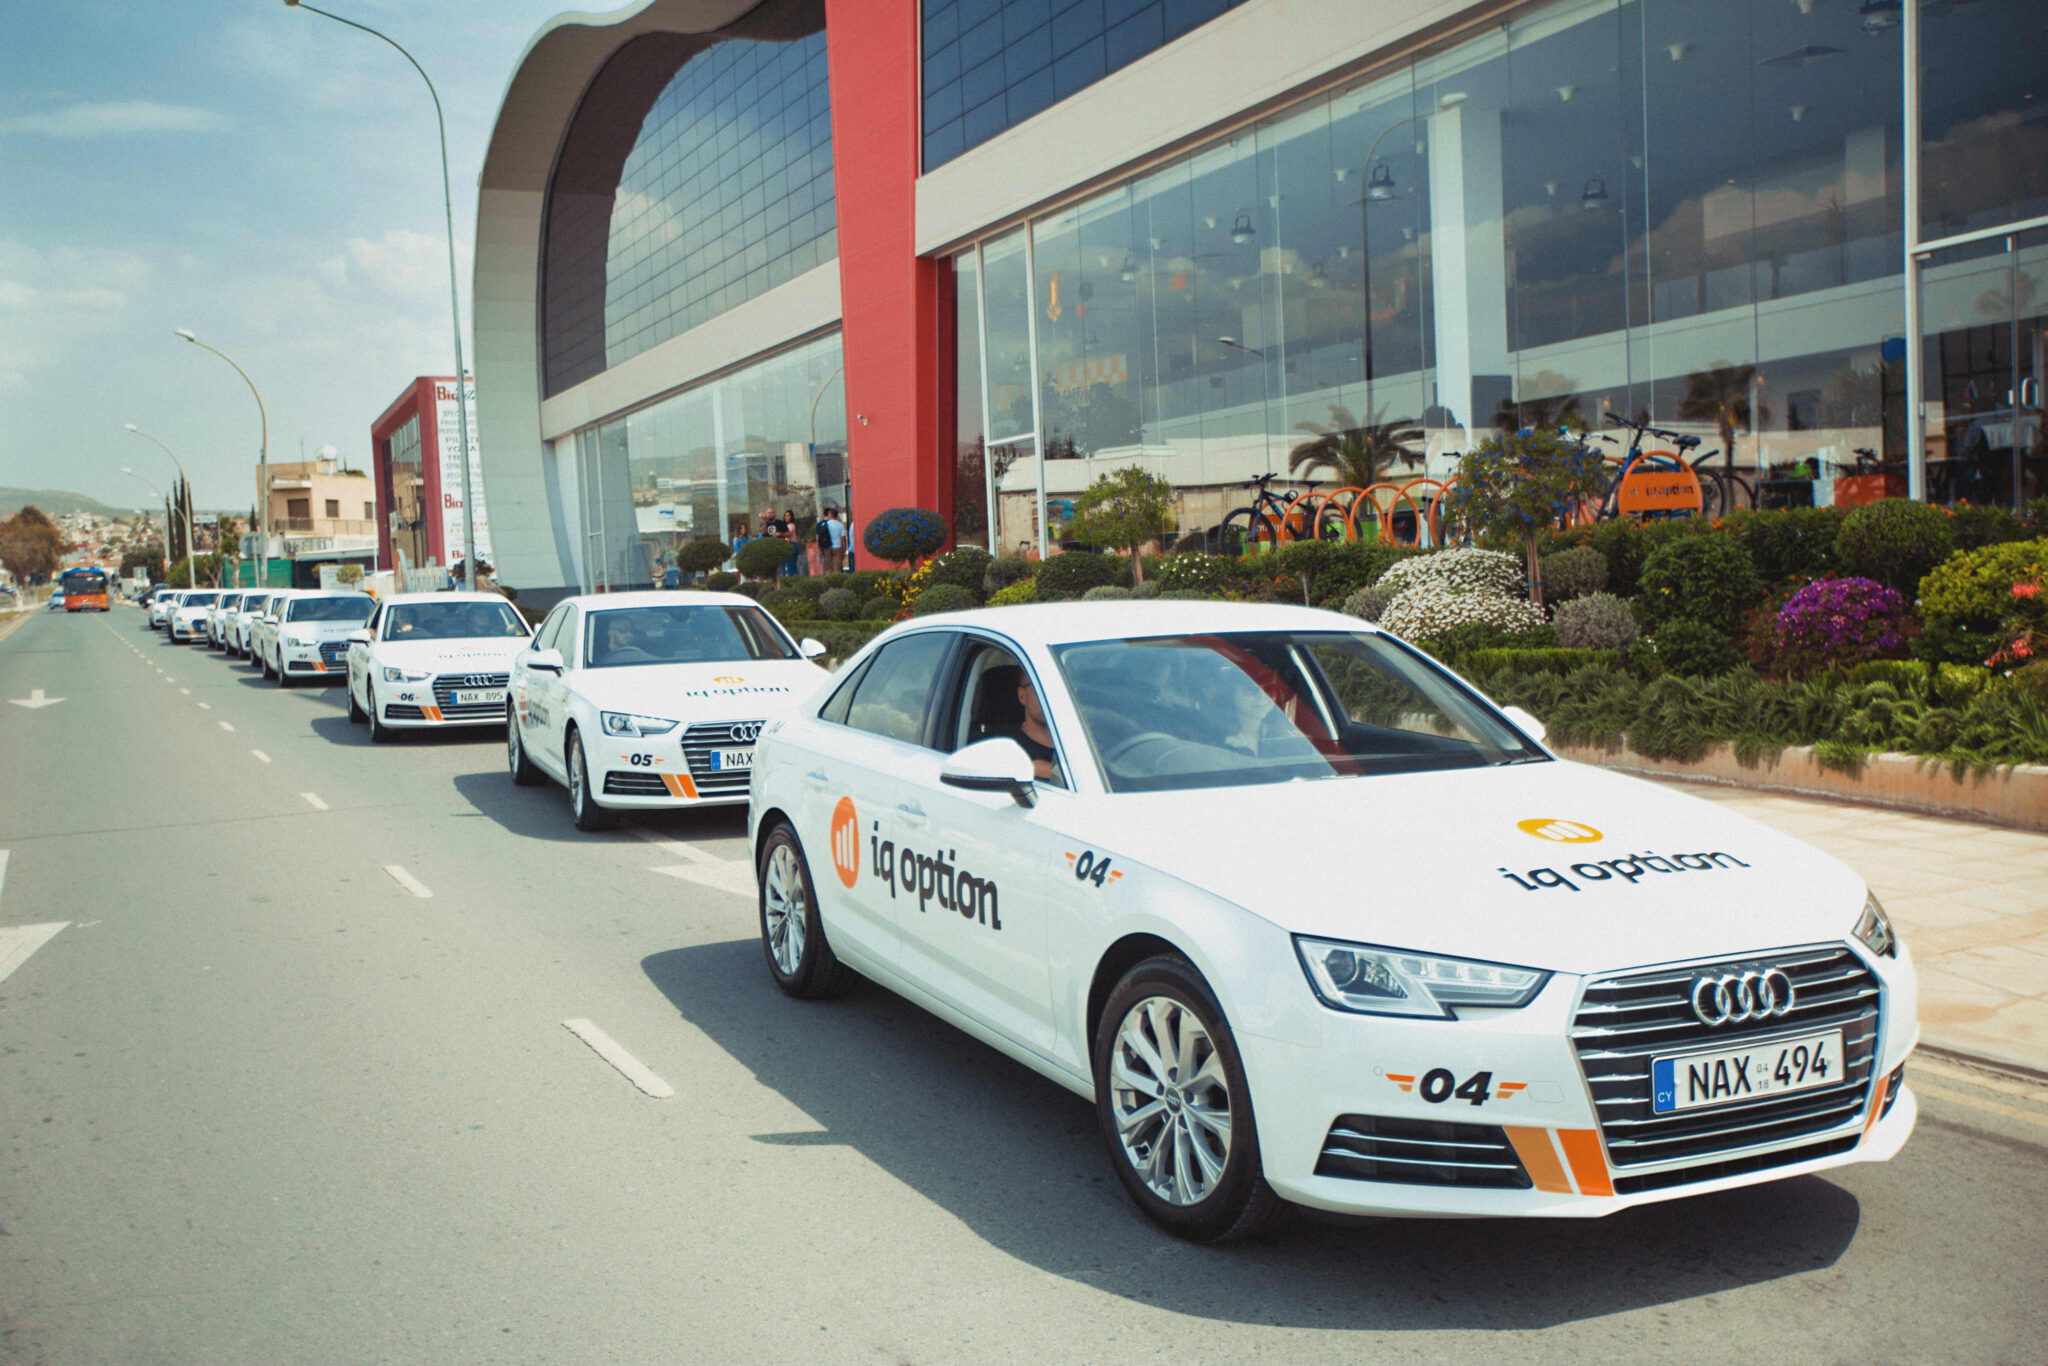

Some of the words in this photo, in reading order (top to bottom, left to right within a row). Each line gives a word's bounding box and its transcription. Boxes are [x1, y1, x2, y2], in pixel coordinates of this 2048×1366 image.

[400, 693, 415, 702] 06
[460, 692, 479, 702] NAX
[485, 691, 504, 701] 895
[630, 753, 653, 767] 05
[871, 820, 896, 899] iq
[900, 848, 1002, 931] option
[1075, 850, 1112, 888] 04
[1497, 867, 1581, 892] iq
[1570, 850, 1752, 884] option
[1688, 1055, 1752, 1101] NAX
[1773, 1041, 1828, 1086] 494
[1756, 1063, 1769, 1074] 04
[1419, 1067, 1493, 1106] 04
[1657, 1092, 1673, 1104] CY
